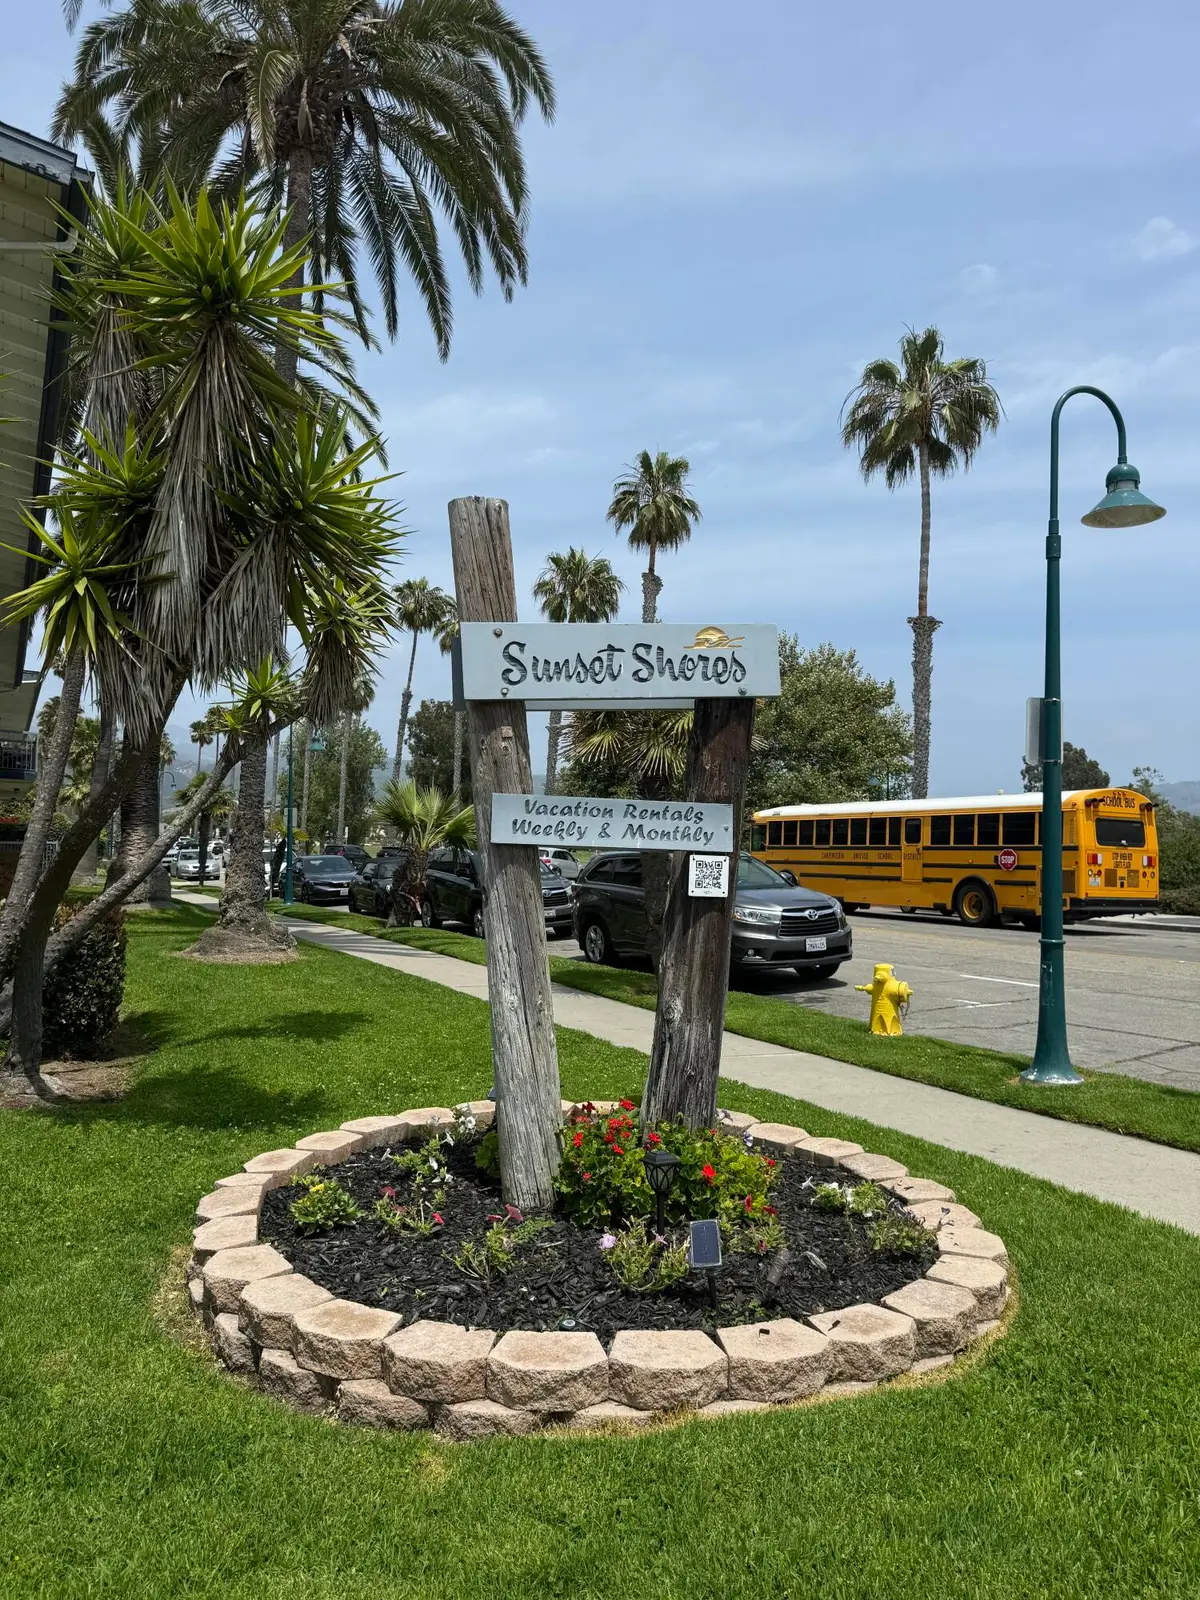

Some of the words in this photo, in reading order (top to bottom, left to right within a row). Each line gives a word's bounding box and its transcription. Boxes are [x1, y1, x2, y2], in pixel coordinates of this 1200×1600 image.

[501, 640, 626, 686] Sunset
[631, 642, 747, 683] Shores
[524, 799, 614, 818] Vacation
[623, 803, 704, 825] Rentals
[1103, 795, 1123, 808] SCHOOL
[1125, 797, 1136, 809] BUS
[512, 818, 588, 841] Weekly
[598, 822, 611, 839] &
[621, 823, 715, 846] Monthly
[877, 852, 893, 861] SCHOOL
[1001, 855, 1015, 864] STOP
